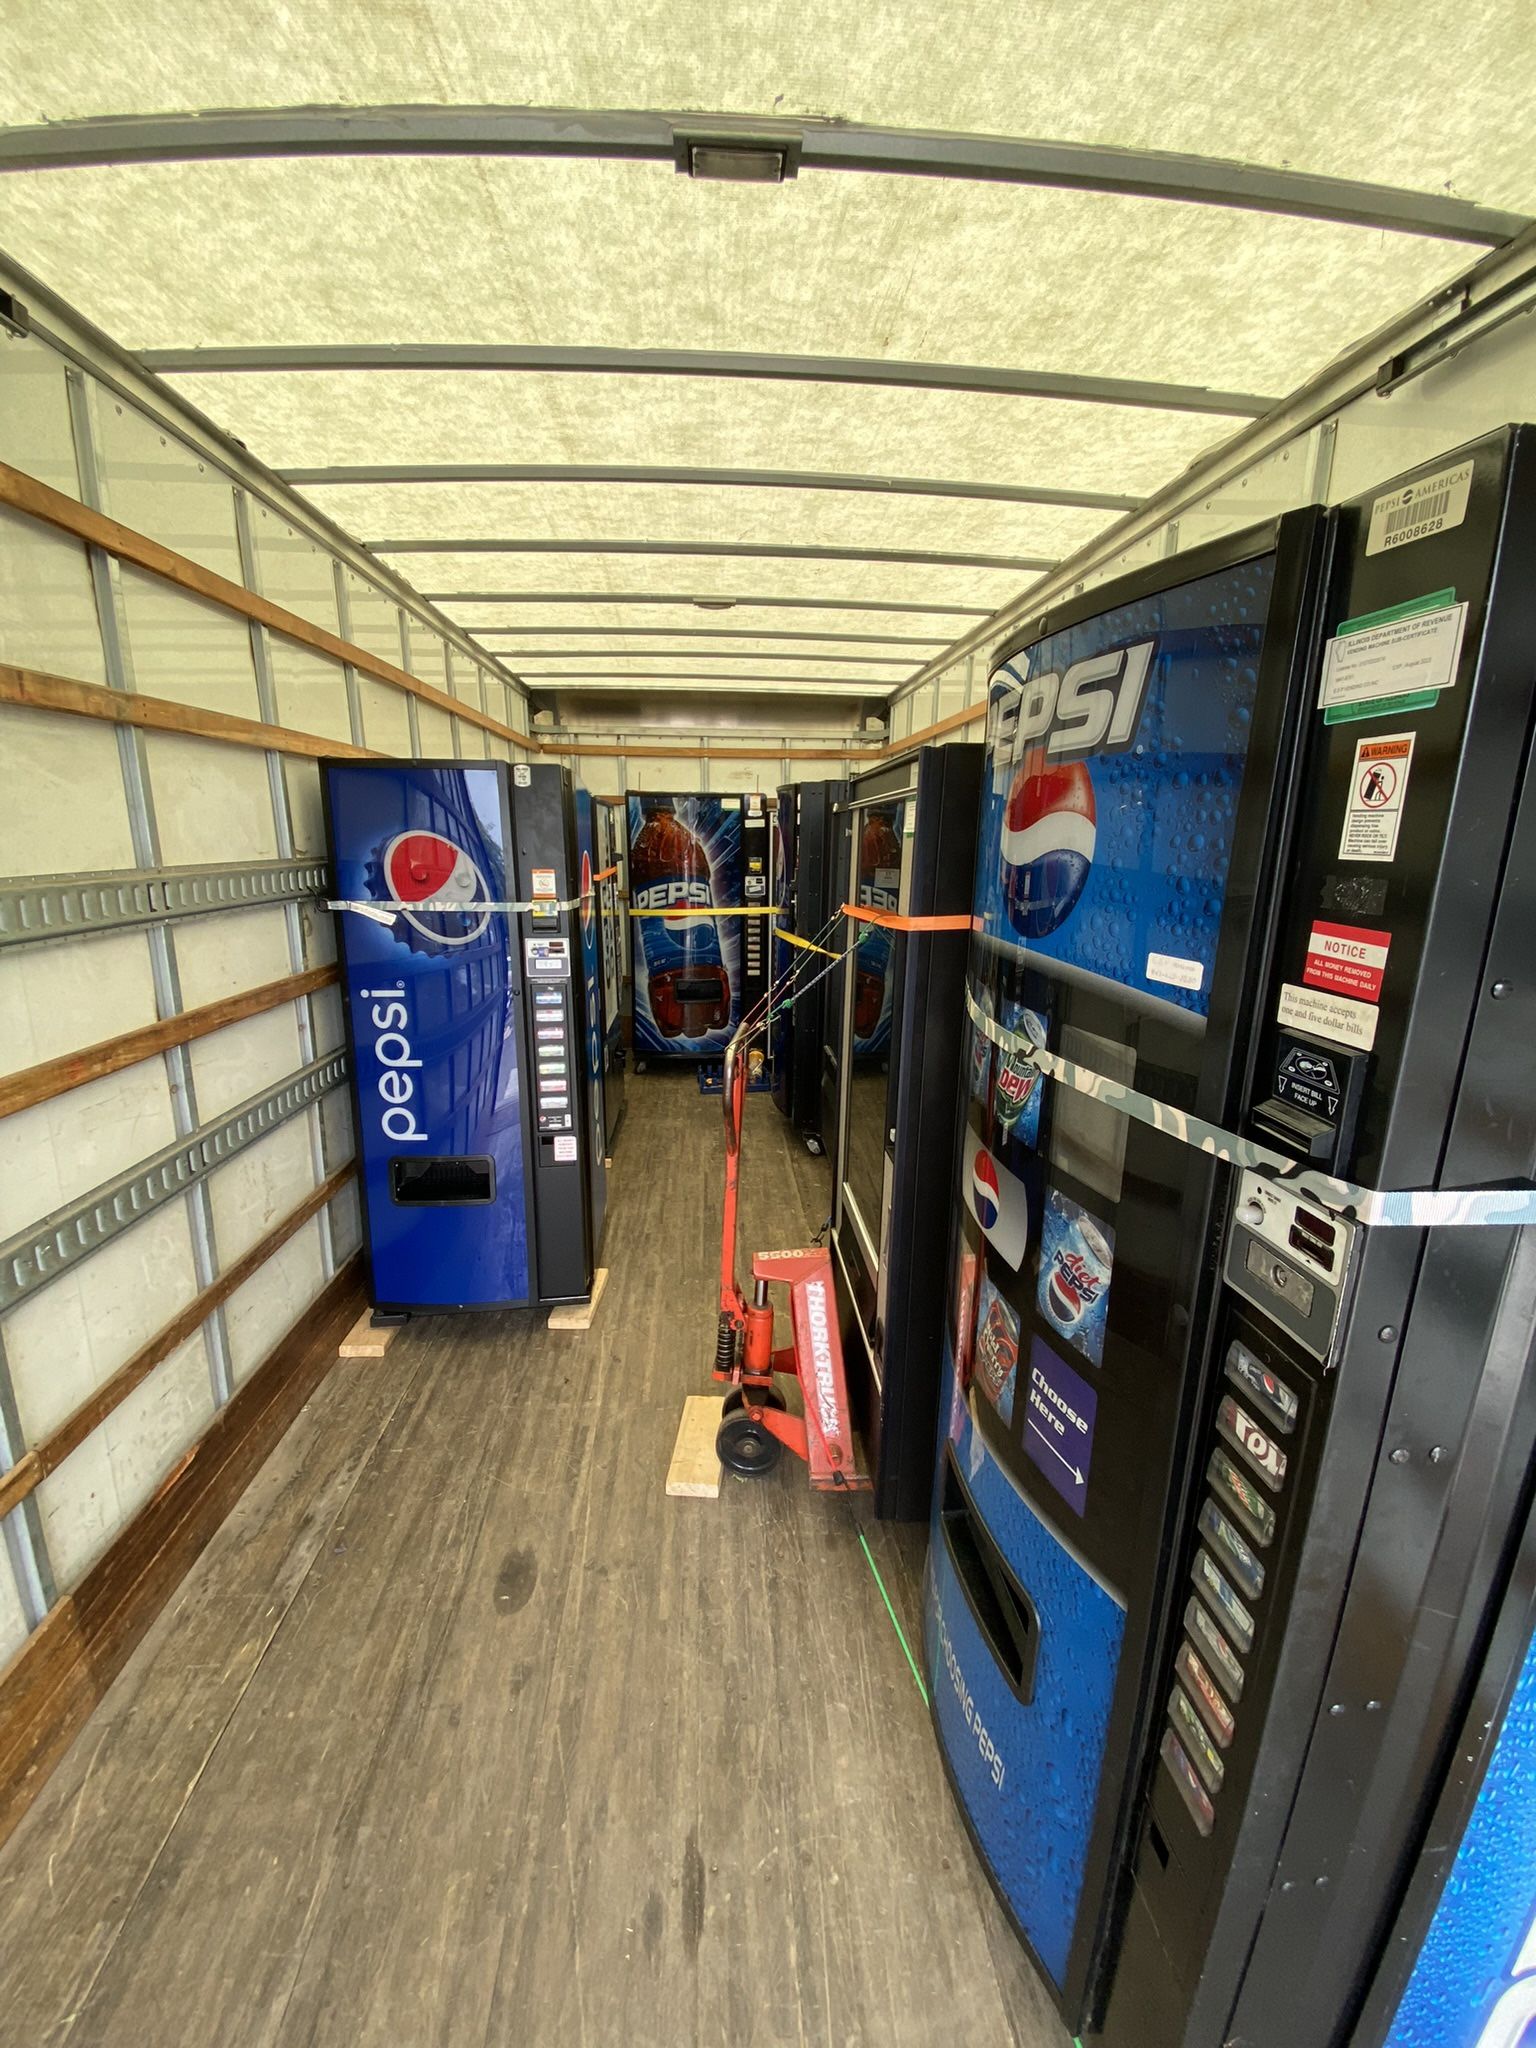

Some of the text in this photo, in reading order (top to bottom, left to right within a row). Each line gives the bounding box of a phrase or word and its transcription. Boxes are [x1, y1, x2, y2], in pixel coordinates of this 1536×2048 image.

[1375, 468, 1470, 515] PEPSI AMERICAS
[1383, 517, 1444, 548] R6008628
[1371, 625, 1411, 641] DEPARTMENT
[1412, 621, 1421, 631] OF
[1422, 613, 1453, 628] REVENUE
[1370, 742, 1408, 757] WARNING
[637, 881, 711, 910] PEPSI
[1324, 940, 1367, 960] NOTICE
[1306, 967, 1376, 991] FROM THIS MACHINE DAILY
[1313, 959, 1372, 979] ALL MONEY REMOVED
[1283, 991, 1357, 1019] This machine accepts
[1281, 1006, 1363, 1036] one and five dollar bills
[360, 989, 428, 1141] pepsi
[1291, 1082, 1322, 1101] INSERT BILL
[1294, 1093, 1317, 1107] FACE UP
[757, 1249, 804, 1261] 5500
[1053, 1249, 1099, 1305] PEPSI
[1065, 1253, 1100, 1290] diet
[1029, 1388, 1066, 1437] Here
[1031, 1367, 1089, 1435] Choose
[940, 1620, 1006, 1791] CHOOSING PEPSI
